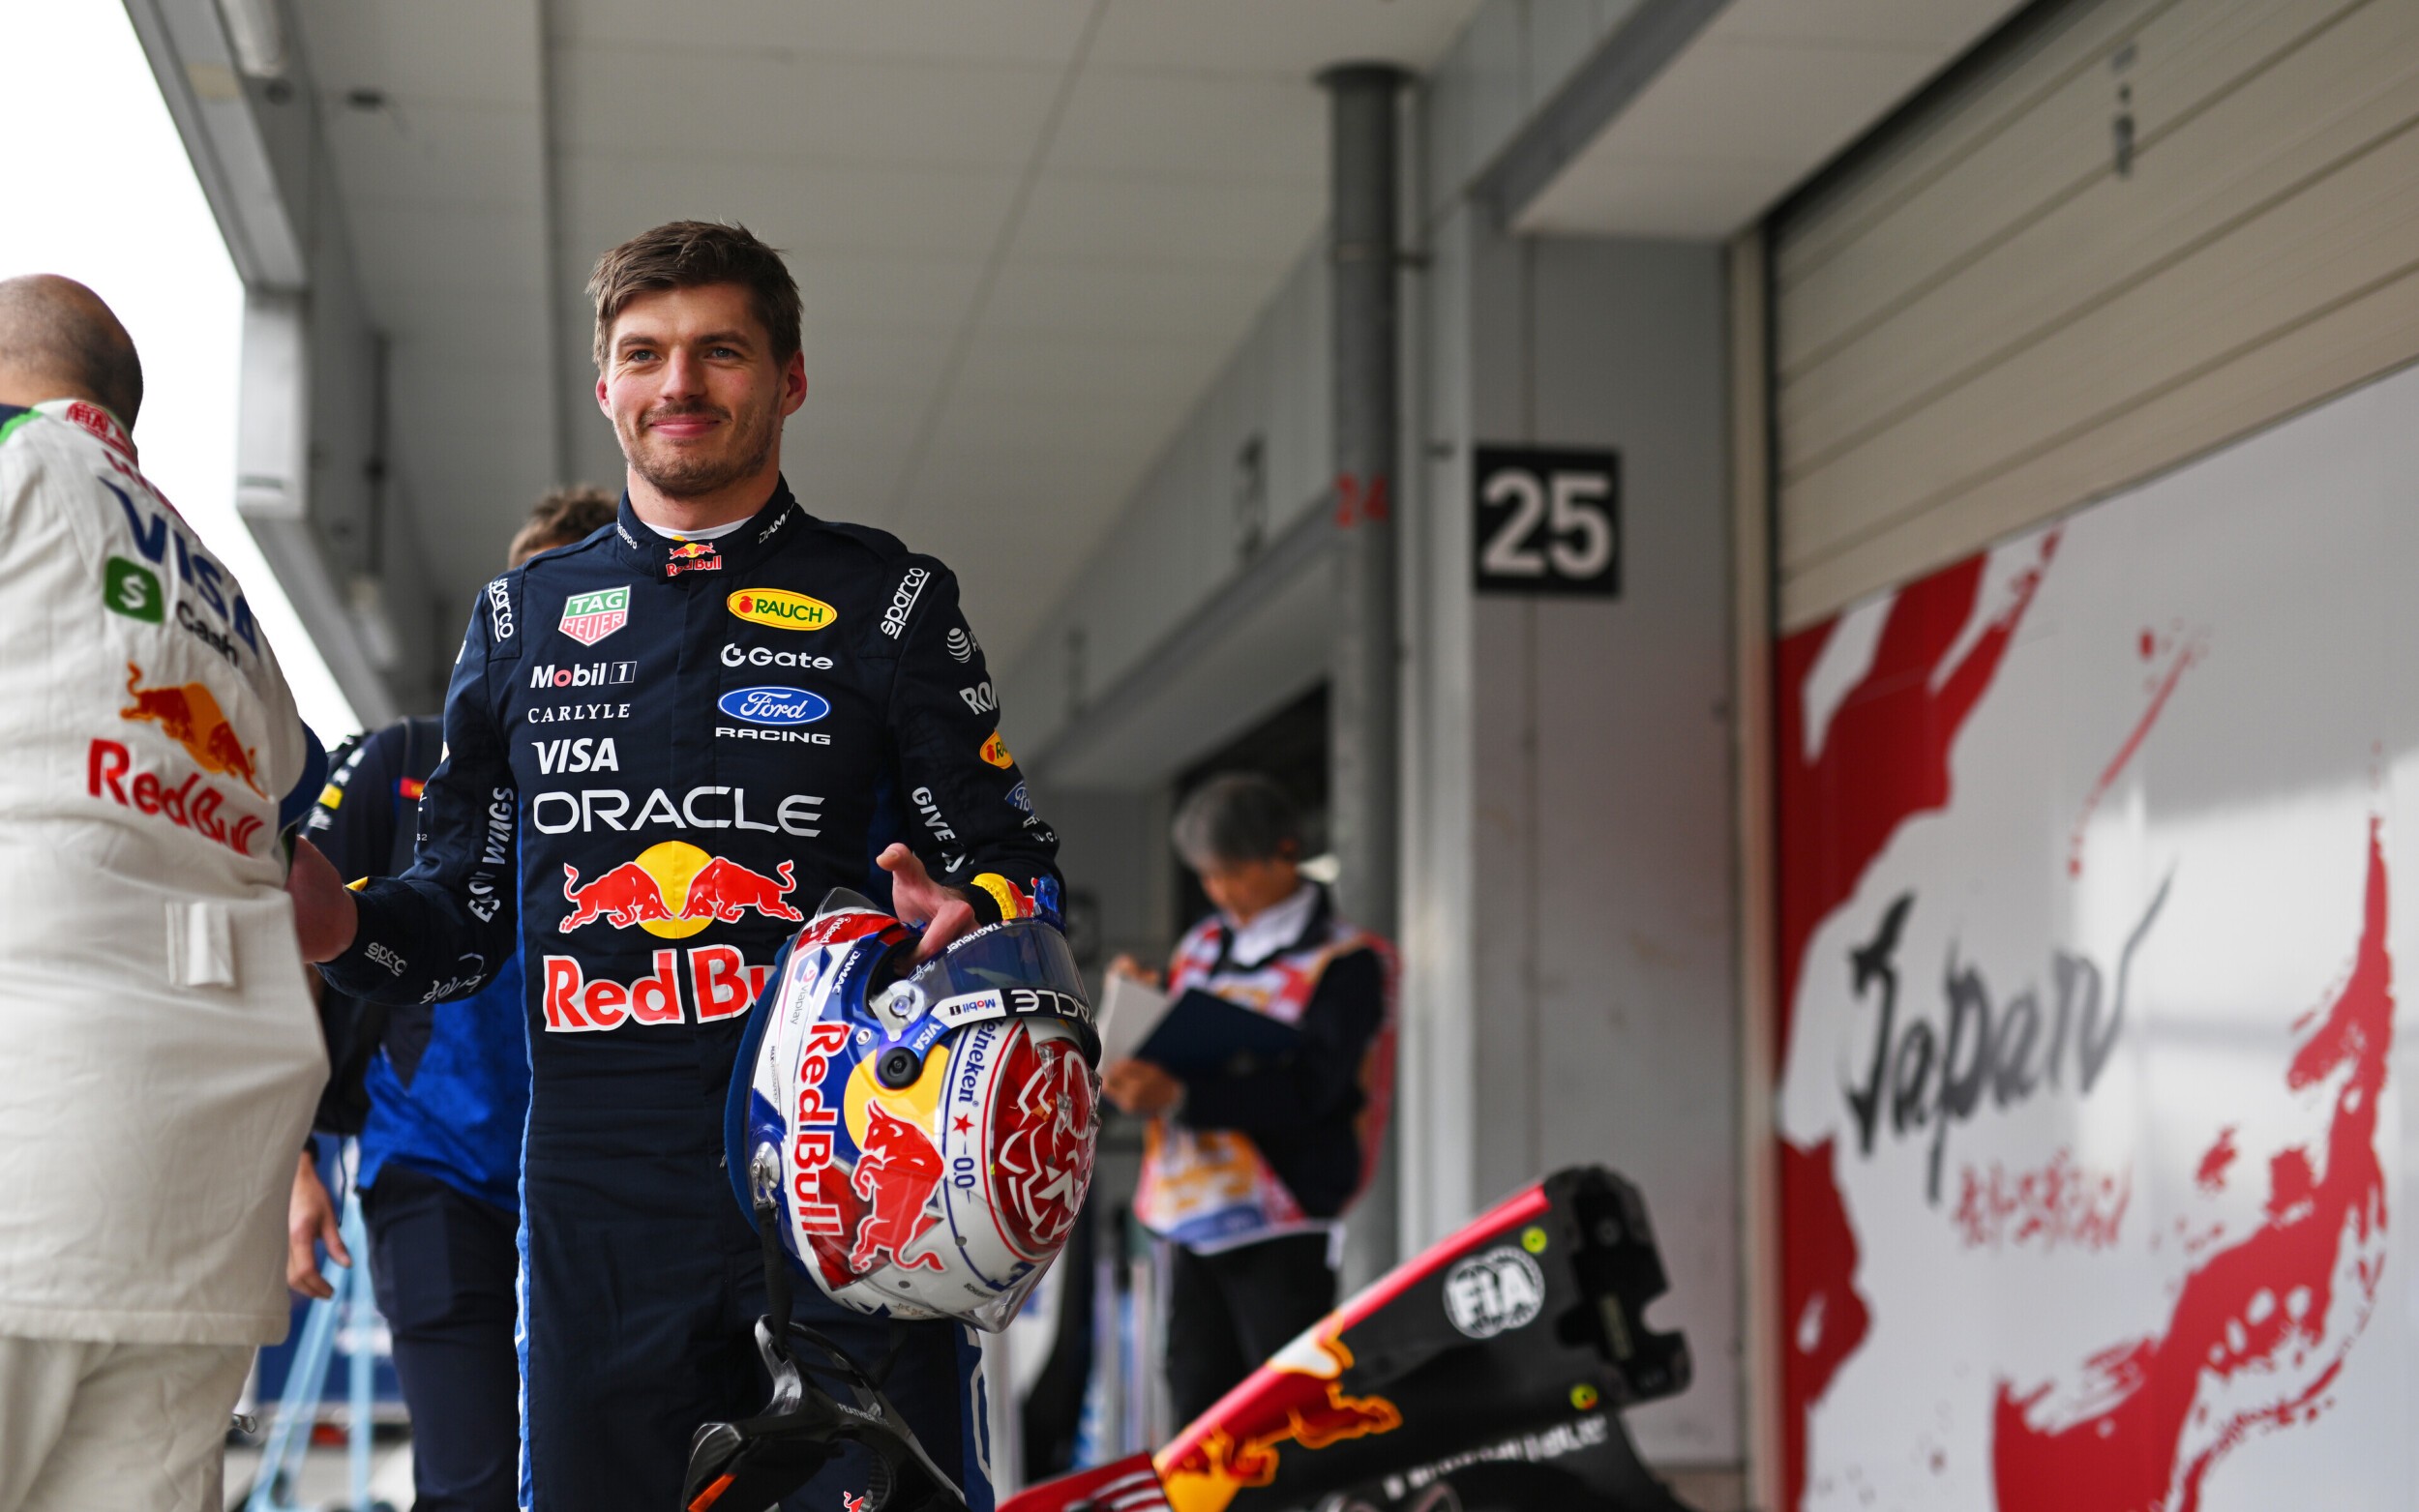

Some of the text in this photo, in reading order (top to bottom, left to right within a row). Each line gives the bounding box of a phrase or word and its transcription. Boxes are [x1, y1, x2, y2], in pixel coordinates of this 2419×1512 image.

[759, 504, 794, 545] DAM
[1482, 469, 1611, 578] 25
[98, 475, 260, 663] VISA
[666, 555, 722, 578] Red Bull
[490, 578, 514, 639] sparco
[572, 591, 624, 614] TAG
[756, 597, 823, 623] RAUCH
[881, 567, 927, 638] sparco
[176, 599, 239, 667] Cash
[564, 612, 622, 643] HEUER
[530, 663, 606, 688] Mobil
[749, 647, 834, 669] Gate
[527, 703, 631, 724] CARLYLE
[739, 691, 808, 720] Ford
[531, 737, 619, 774] VISA
[716, 726, 831, 745] RACING
[88, 738, 264, 857] Red Bull
[533, 786, 824, 838] ORACLE
[481, 786, 515, 865] WINGS
[821, 917, 851, 945] indeed
[543, 949, 684, 1031] Red
[832, 950, 861, 995] DAMAC
[790, 984, 810, 1025] viaplay
[962, 997, 997, 1014] Mobil
[1011, 989, 1097, 1029] ACLE
[912, 1022, 942, 1052] VISA
[1845, 856, 2179, 1206] Japan
[793, 1023, 851, 1234] Red Bull
[1448, 1262, 1537, 1328] FIA
